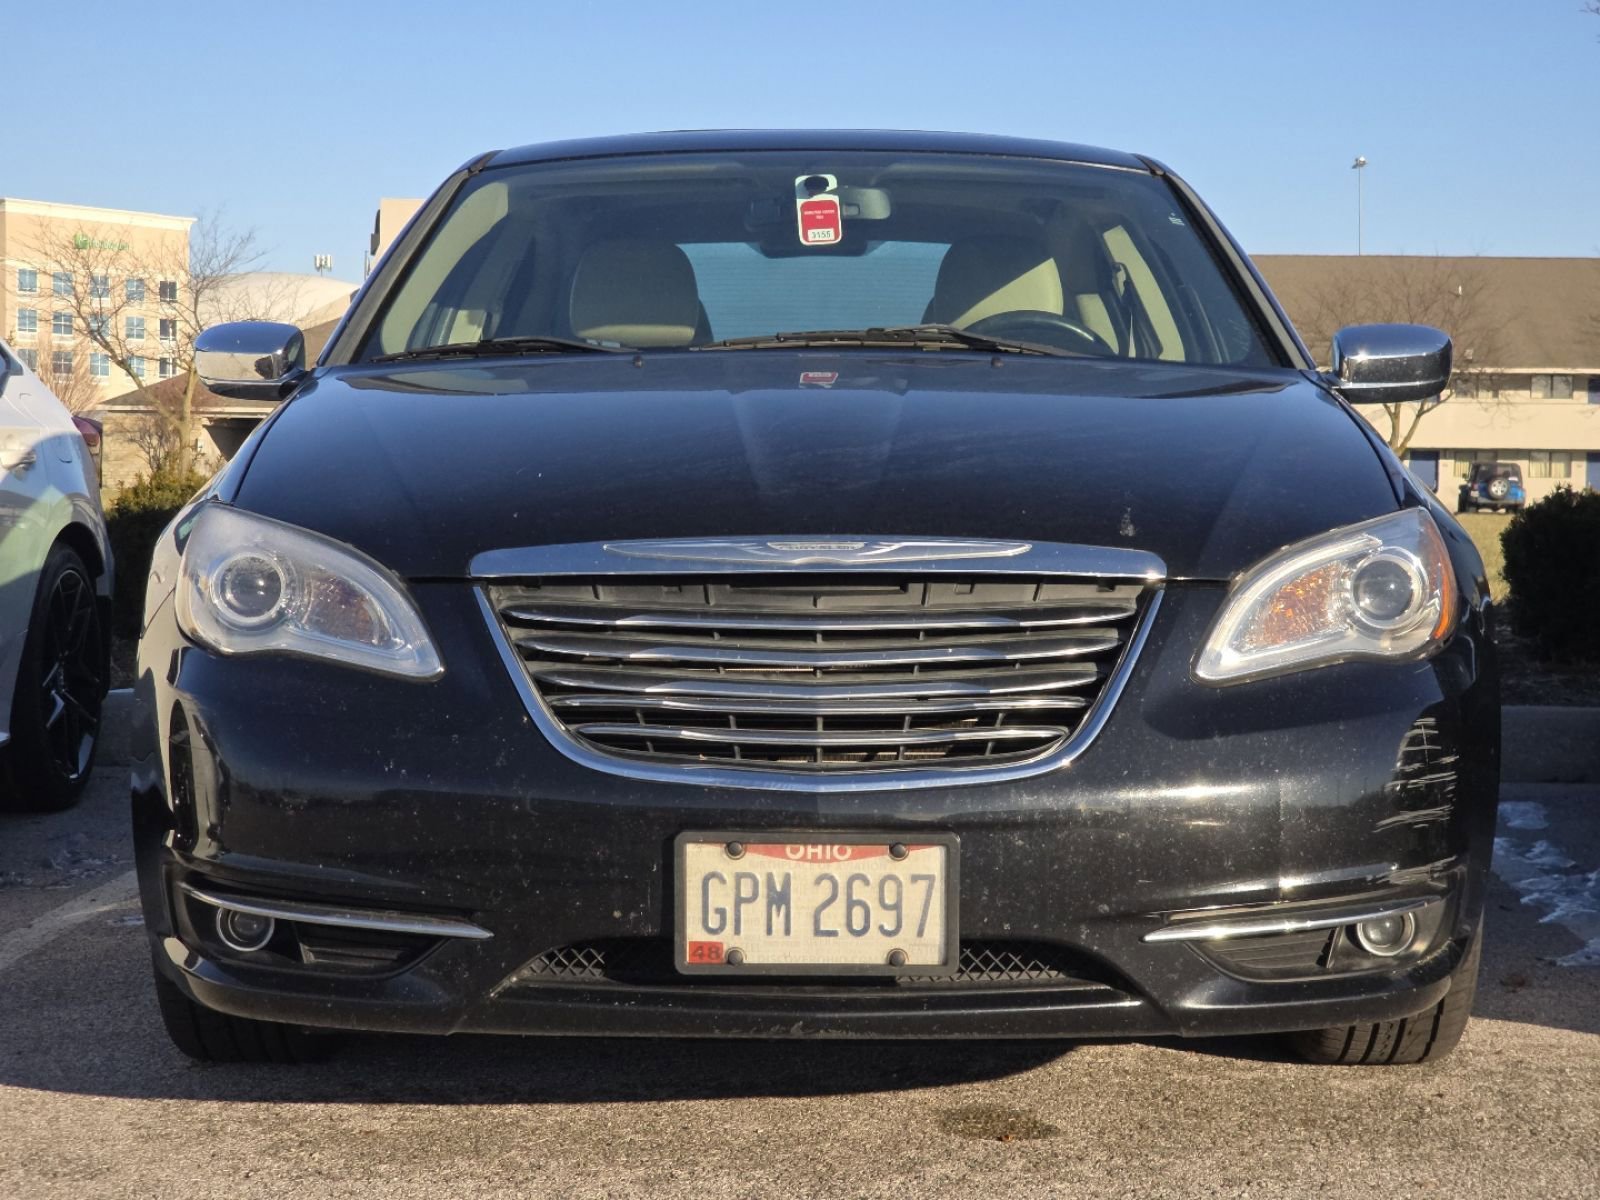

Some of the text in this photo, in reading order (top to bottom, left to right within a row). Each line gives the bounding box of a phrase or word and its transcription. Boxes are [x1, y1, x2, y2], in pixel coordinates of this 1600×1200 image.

[785, 844, 852, 860] OHIO
[701, 870, 937, 938] GPM 2697
[691, 945, 721, 960] 48
